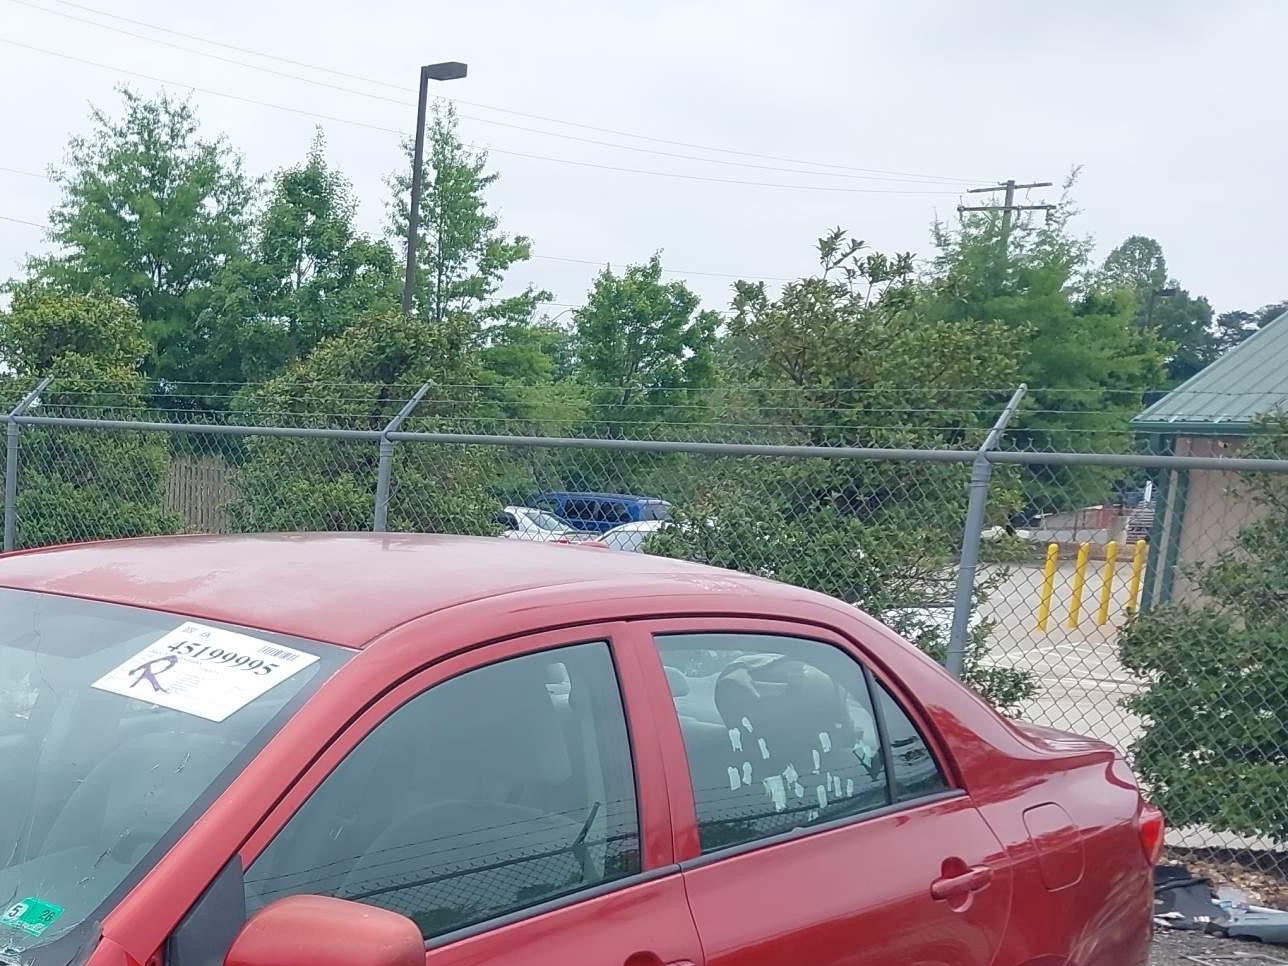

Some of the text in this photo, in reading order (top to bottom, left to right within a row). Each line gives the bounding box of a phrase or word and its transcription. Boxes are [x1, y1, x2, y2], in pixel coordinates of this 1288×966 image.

[128, 655, 179, 694] R
[167, 640, 279, 676] 45199995
[8, 904, 56, 922] 5 26
